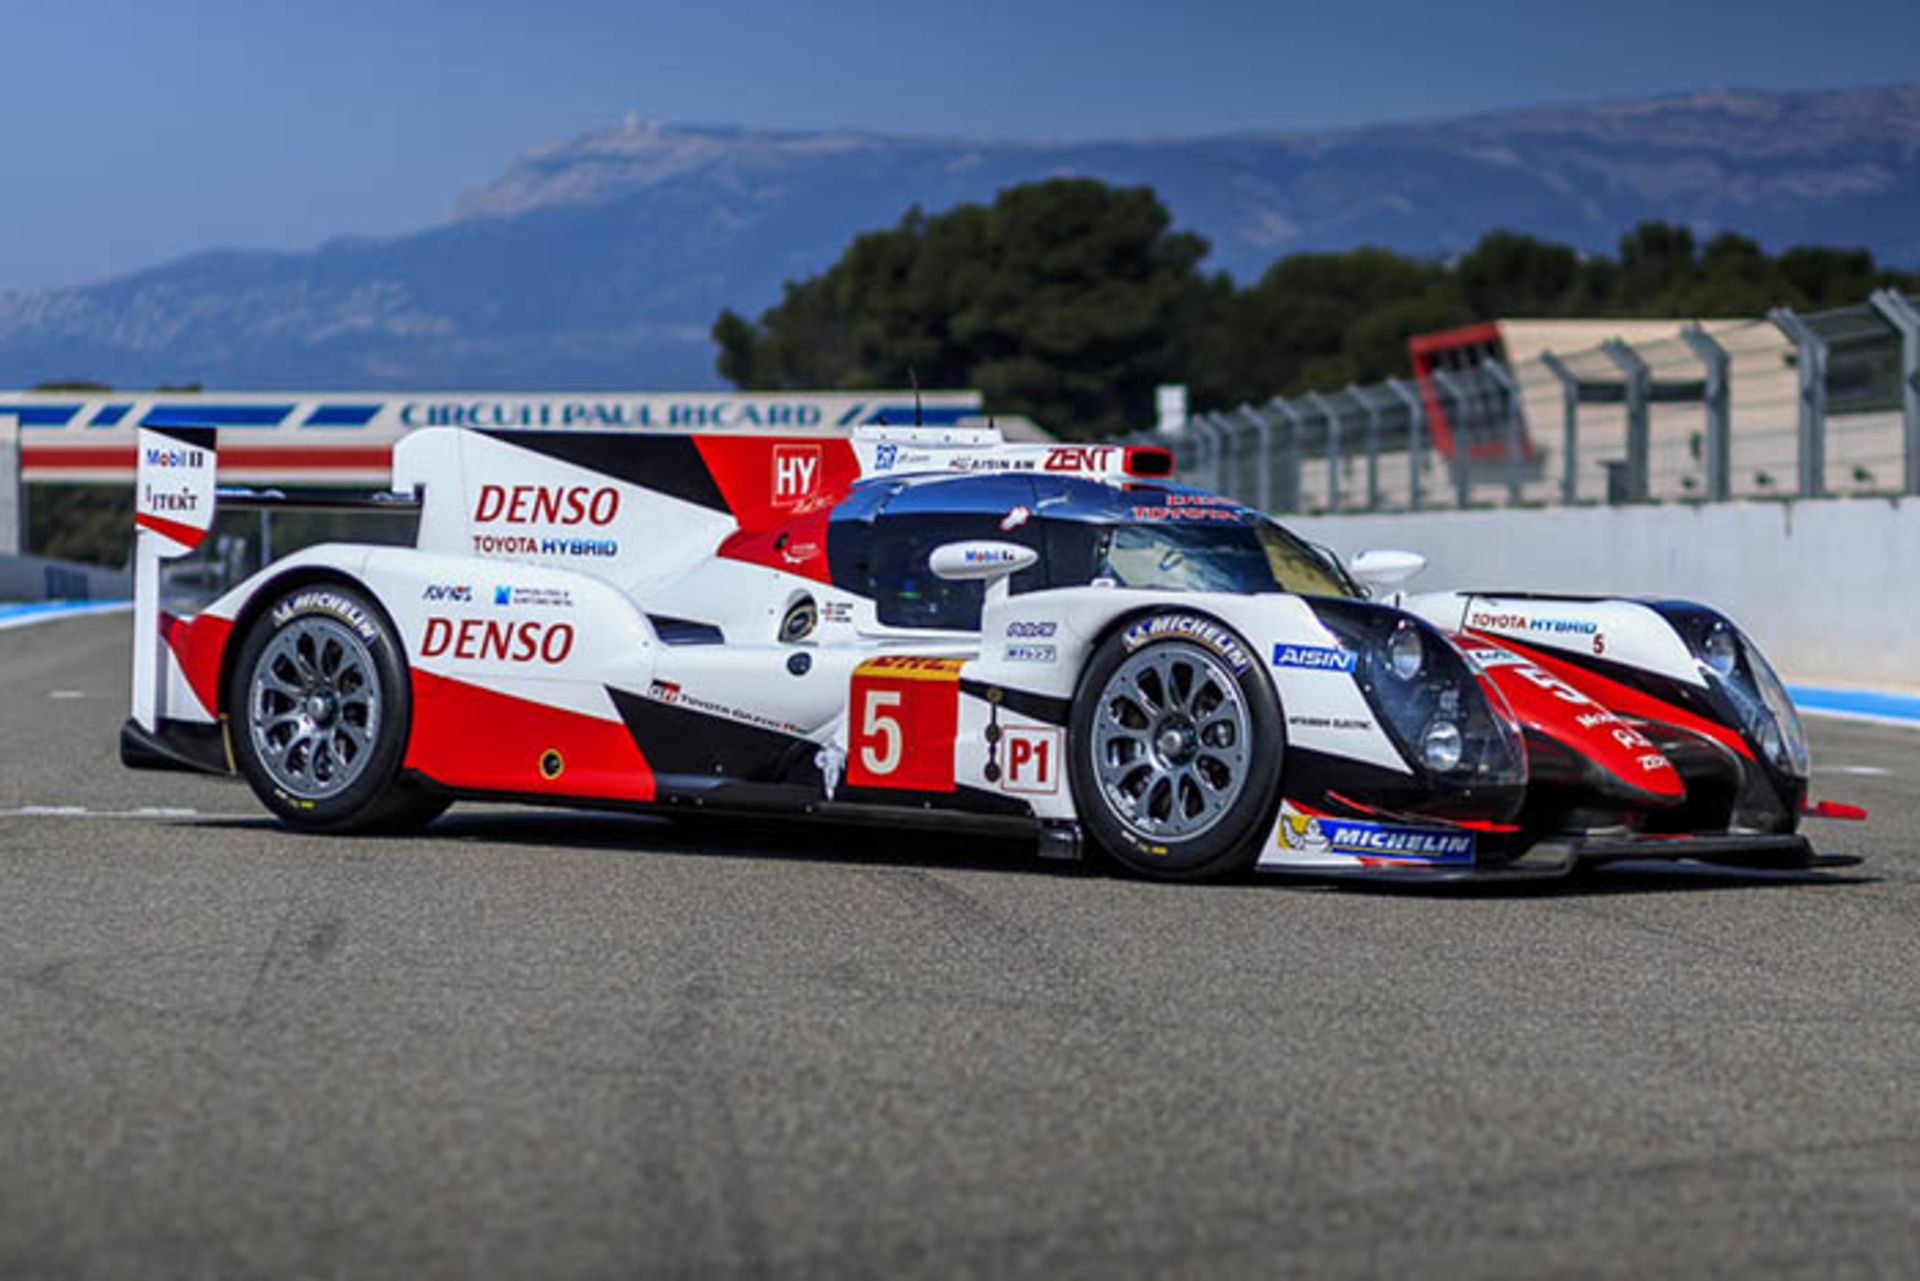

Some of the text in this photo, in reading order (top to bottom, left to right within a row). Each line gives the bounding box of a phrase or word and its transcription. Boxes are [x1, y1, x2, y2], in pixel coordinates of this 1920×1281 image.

[400, 402, 821, 428] CIRCUIT PAUL RICARD
[146, 448, 187, 467] Mobil
[1043, 448, 1116, 471] ZENT
[776, 456, 816, 495] HY
[152, 490, 198, 511] JTEKT
[474, 484, 620, 526] DENSO
[473, 534, 618, 557] TOYOTA HYBRID
[292, 591, 376, 643] MICHELIN
[1472, 613, 1598, 635] TOYOTA HYBRID
[420, 616, 574, 664] DENSO
[1149, 614, 1248, 669] MICHELIN
[1592, 633, 1605, 655] 5
[1278, 646, 1351, 669] AISIN
[861, 690, 903, 775] 5
[1009, 737, 1049, 783] P1
[1332, 827, 1471, 852] MICHELIN
